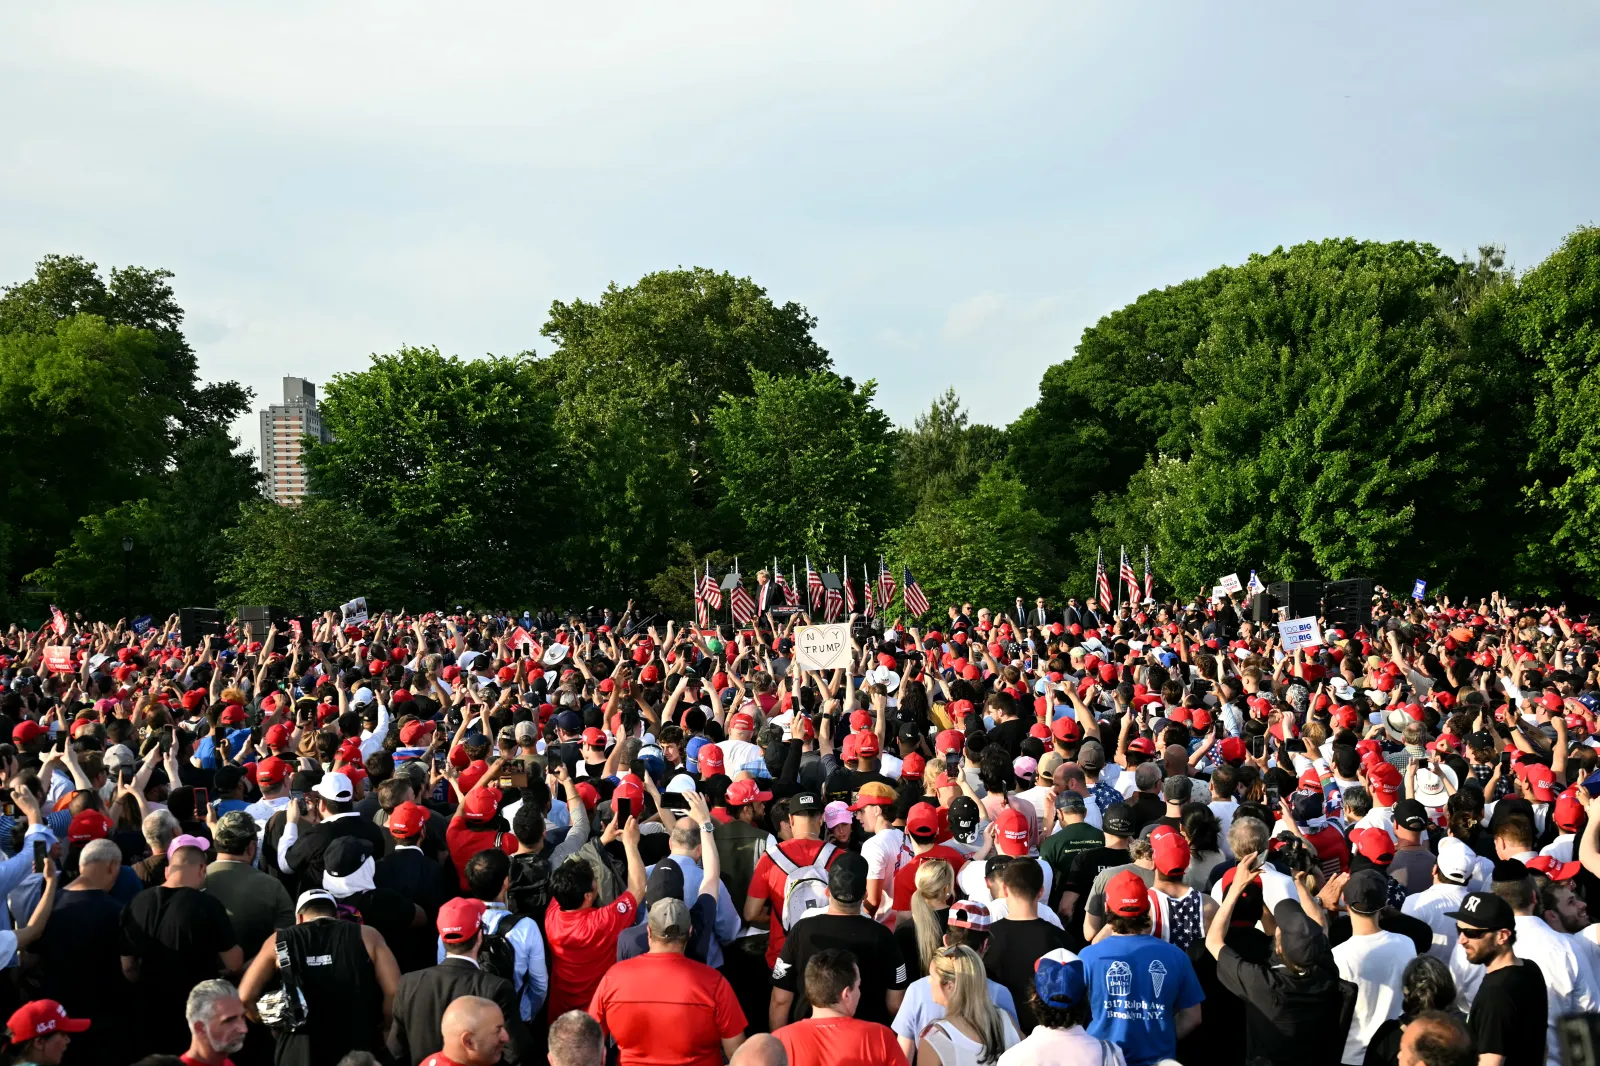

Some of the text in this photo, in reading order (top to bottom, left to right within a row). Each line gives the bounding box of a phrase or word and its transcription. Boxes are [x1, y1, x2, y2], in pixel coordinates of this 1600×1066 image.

[1298, 623, 1312, 631] BIG
[806, 630, 839, 641] N Y
[1298, 633, 1312, 641] RIG
[804, 643, 840, 653] TRUMP
[1103, 1000, 1166, 1010] 2317 Ralph Ave
[1107, 1011, 1163, 1020] Brooklyn, NY.
[36, 1019, 56, 1034] 45-47
